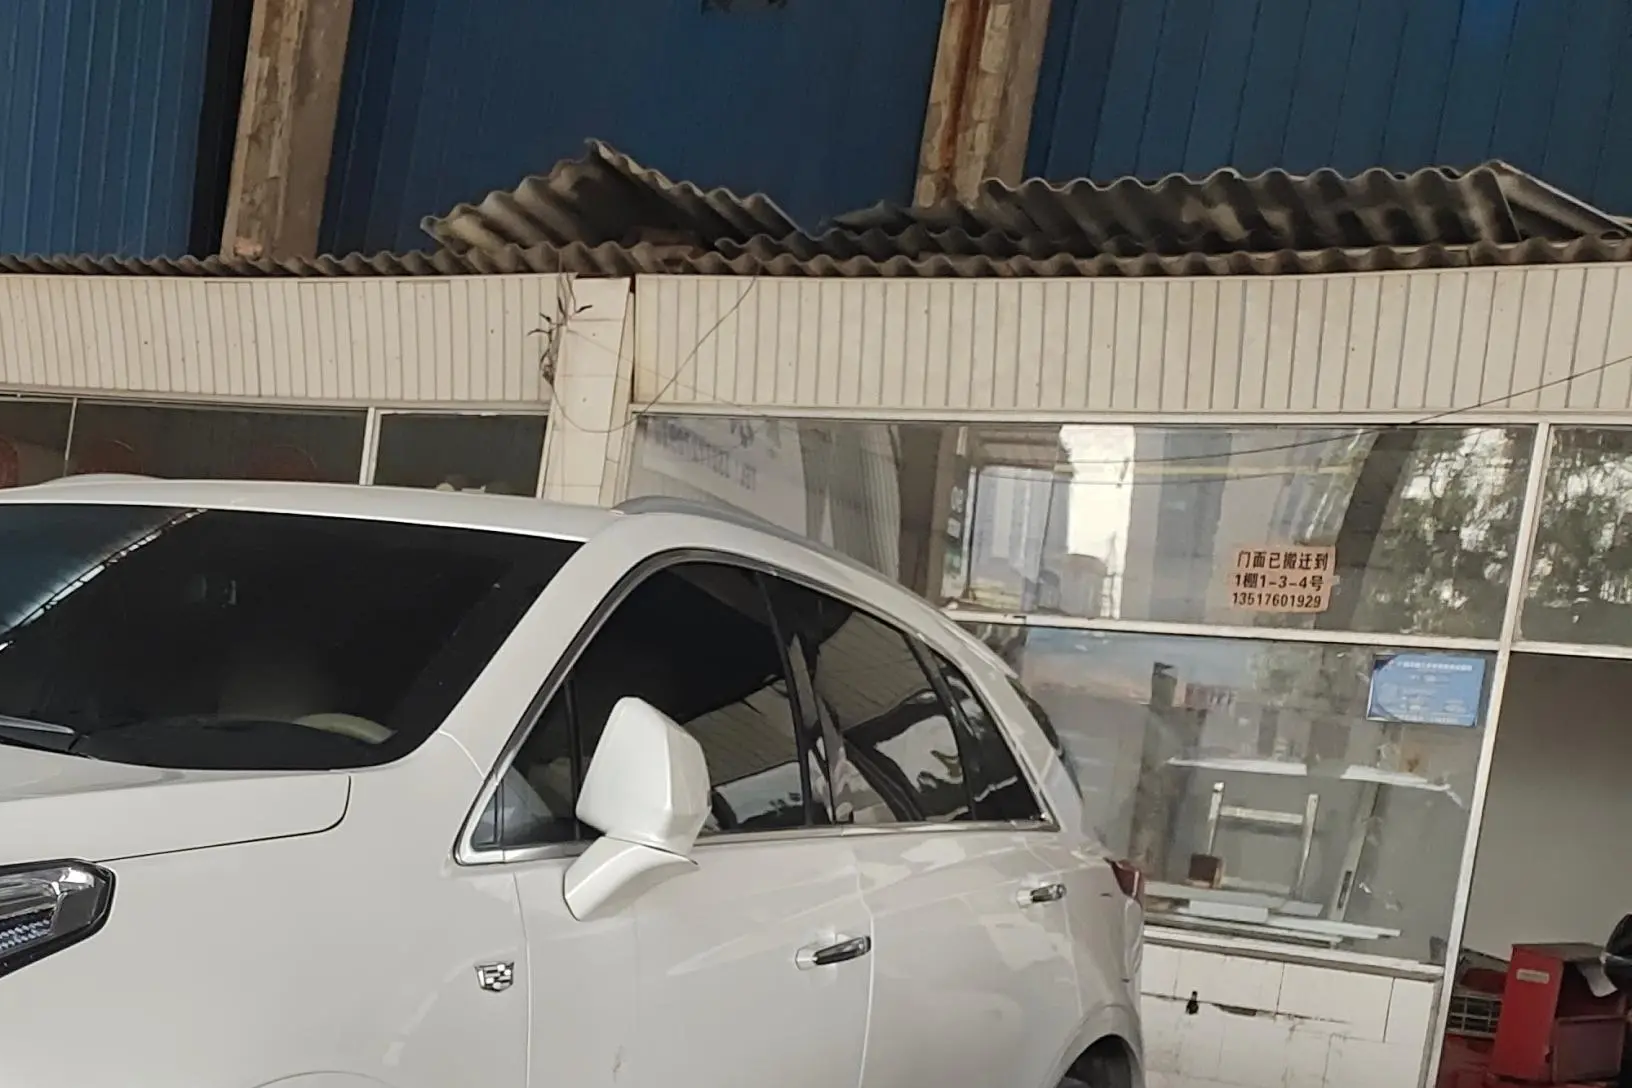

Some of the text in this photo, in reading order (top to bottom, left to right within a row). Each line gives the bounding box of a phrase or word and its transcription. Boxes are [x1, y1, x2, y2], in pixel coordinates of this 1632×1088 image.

[1237, 550, 1328, 571] 门面已搬迁到
[1235, 572, 1324, 592] 1棚1-3-4号
[1233, 592, 1322, 608] 13517601929
